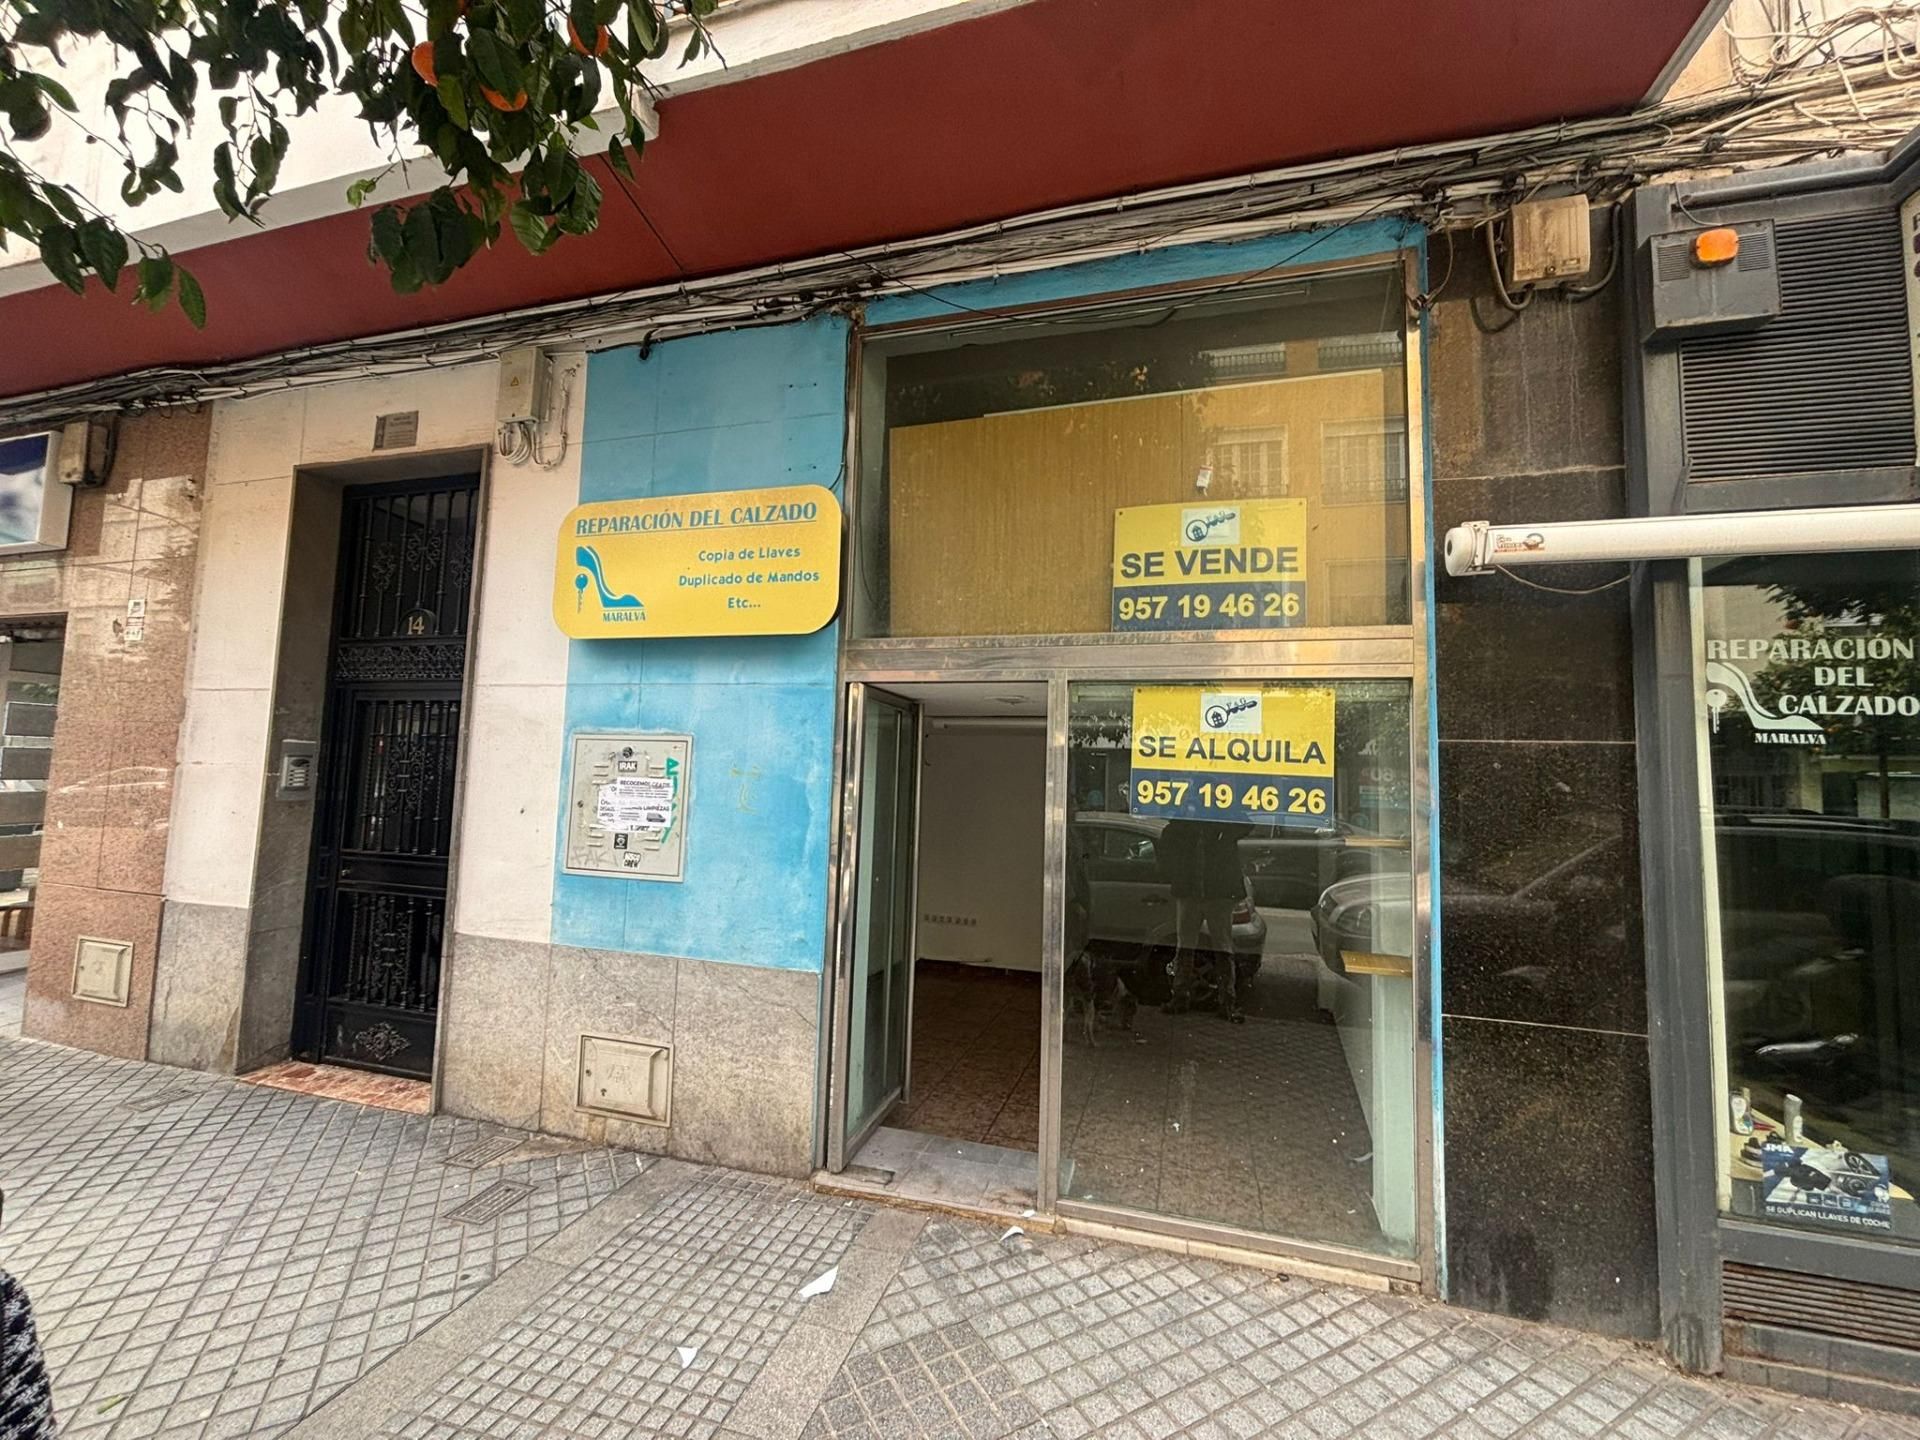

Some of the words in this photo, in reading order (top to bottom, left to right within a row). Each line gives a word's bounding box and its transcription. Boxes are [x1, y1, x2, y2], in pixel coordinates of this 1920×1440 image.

[576, 509, 682, 534] REPARACIÓN
[689, 509, 723, 527] DEL
[730, 502, 817, 522] CALZADO
[698, 550, 735, 563] Copia
[738, 549, 755, 560] de
[759, 547, 801, 559] Llaves
[1121, 551, 1164, 579] SE
[1175, 546, 1298, 576] VENDE
[679, 574, 742, 588] Duplicado
[746, 573, 763, 584] de
[767, 570, 819, 583] Mandos
[727, 597, 761, 609] Etc...
[1118, 596, 1168, 620] 957
[1178, 594, 1210, 617] 19
[1219, 593, 1255, 617] 46
[1264, 592, 1300, 617] 26
[407, 615, 425, 635] 14
[602, 610, 646, 623] MARALVA
[1707, 632, 1915, 660] REPARACIÓN
[1814, 666, 1874, 687] DEL
[1778, 694, 1920, 716] CALZADO
[1754, 732, 1827, 745] MARALVA
[1138, 736, 1176, 759] SE
[1185, 737, 1326, 765] ALQUILA
[1136, 780, 1189, 806] 957
[1199, 783, 1233, 809] 19
[1241, 785, 1279, 811] 46
[1287, 788, 1326, 813] 26
[1777, 1207, 1817, 1218] DUPLICAN
[1818, 1211, 1849, 1223] LLAVES
[1850, 1216, 1861, 1225] DE
